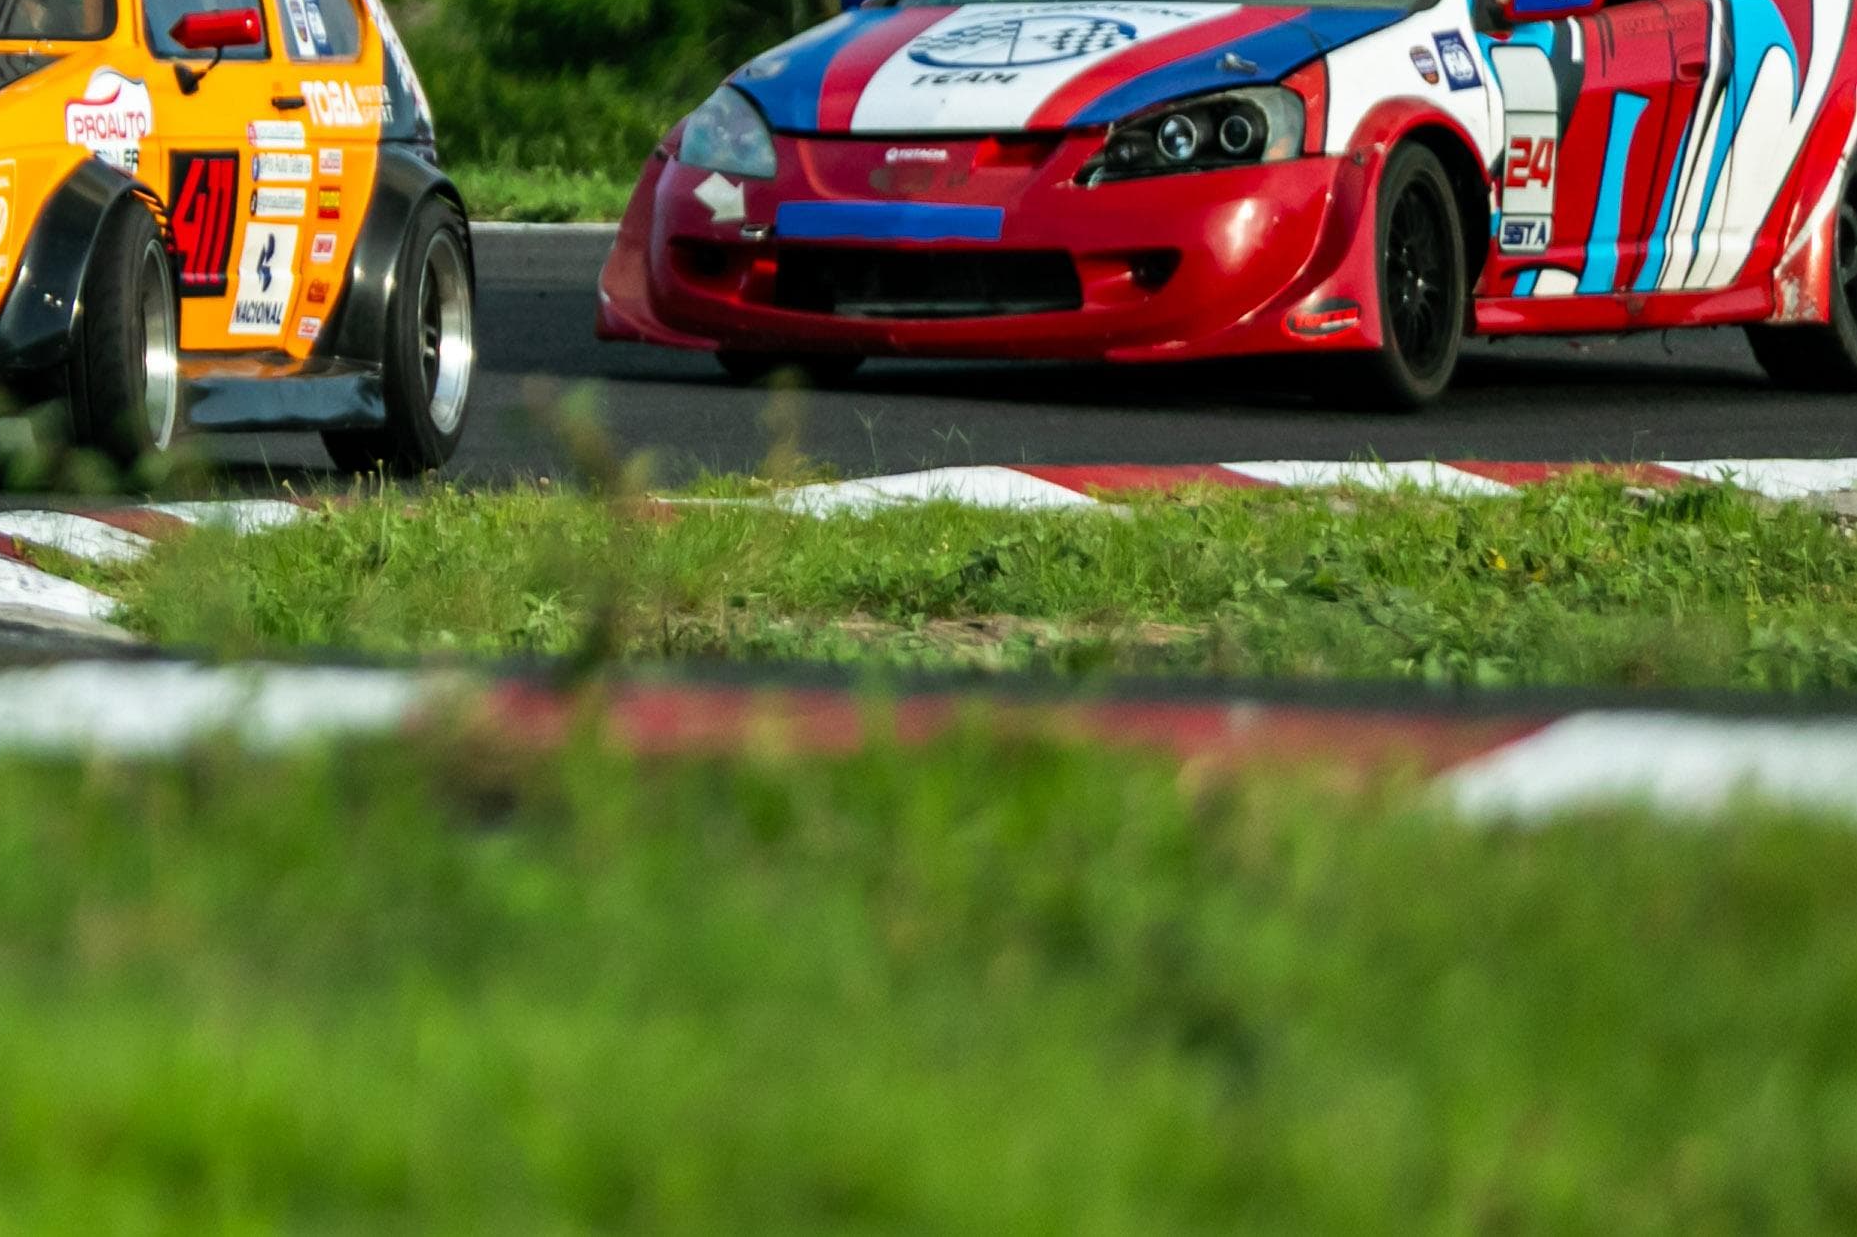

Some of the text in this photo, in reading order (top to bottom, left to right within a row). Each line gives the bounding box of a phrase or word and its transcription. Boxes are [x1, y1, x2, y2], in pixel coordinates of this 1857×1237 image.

[911, 70, 1020, 87] TEAM
[299, 79, 365, 126] TOBA
[74, 112, 147, 140] PROAUTO
[1505, 136, 1555, 189] 24
[171, 157, 236, 286] 411
[233, 299, 284, 325] NACIONAL
